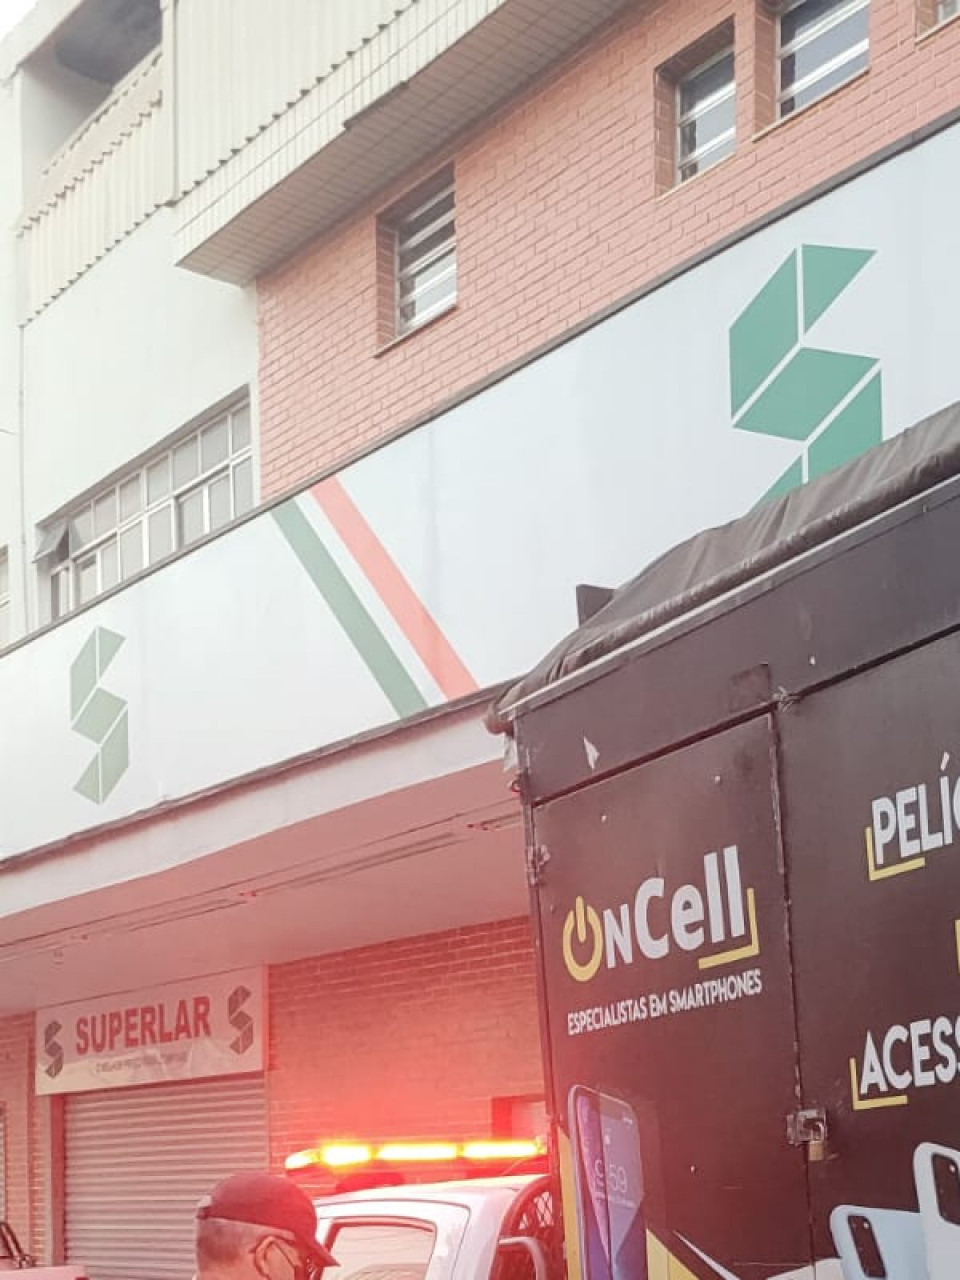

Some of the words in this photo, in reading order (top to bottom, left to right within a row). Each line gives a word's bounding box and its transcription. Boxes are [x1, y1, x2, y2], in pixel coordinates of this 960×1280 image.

[76, 996, 212, 1056] SUPERLAR
[567, 996, 648, 1036] ESPECIALISTAS
[649, 991, 668, 1018] EM
[669, 968, 763, 1014] SMARTPHONES
